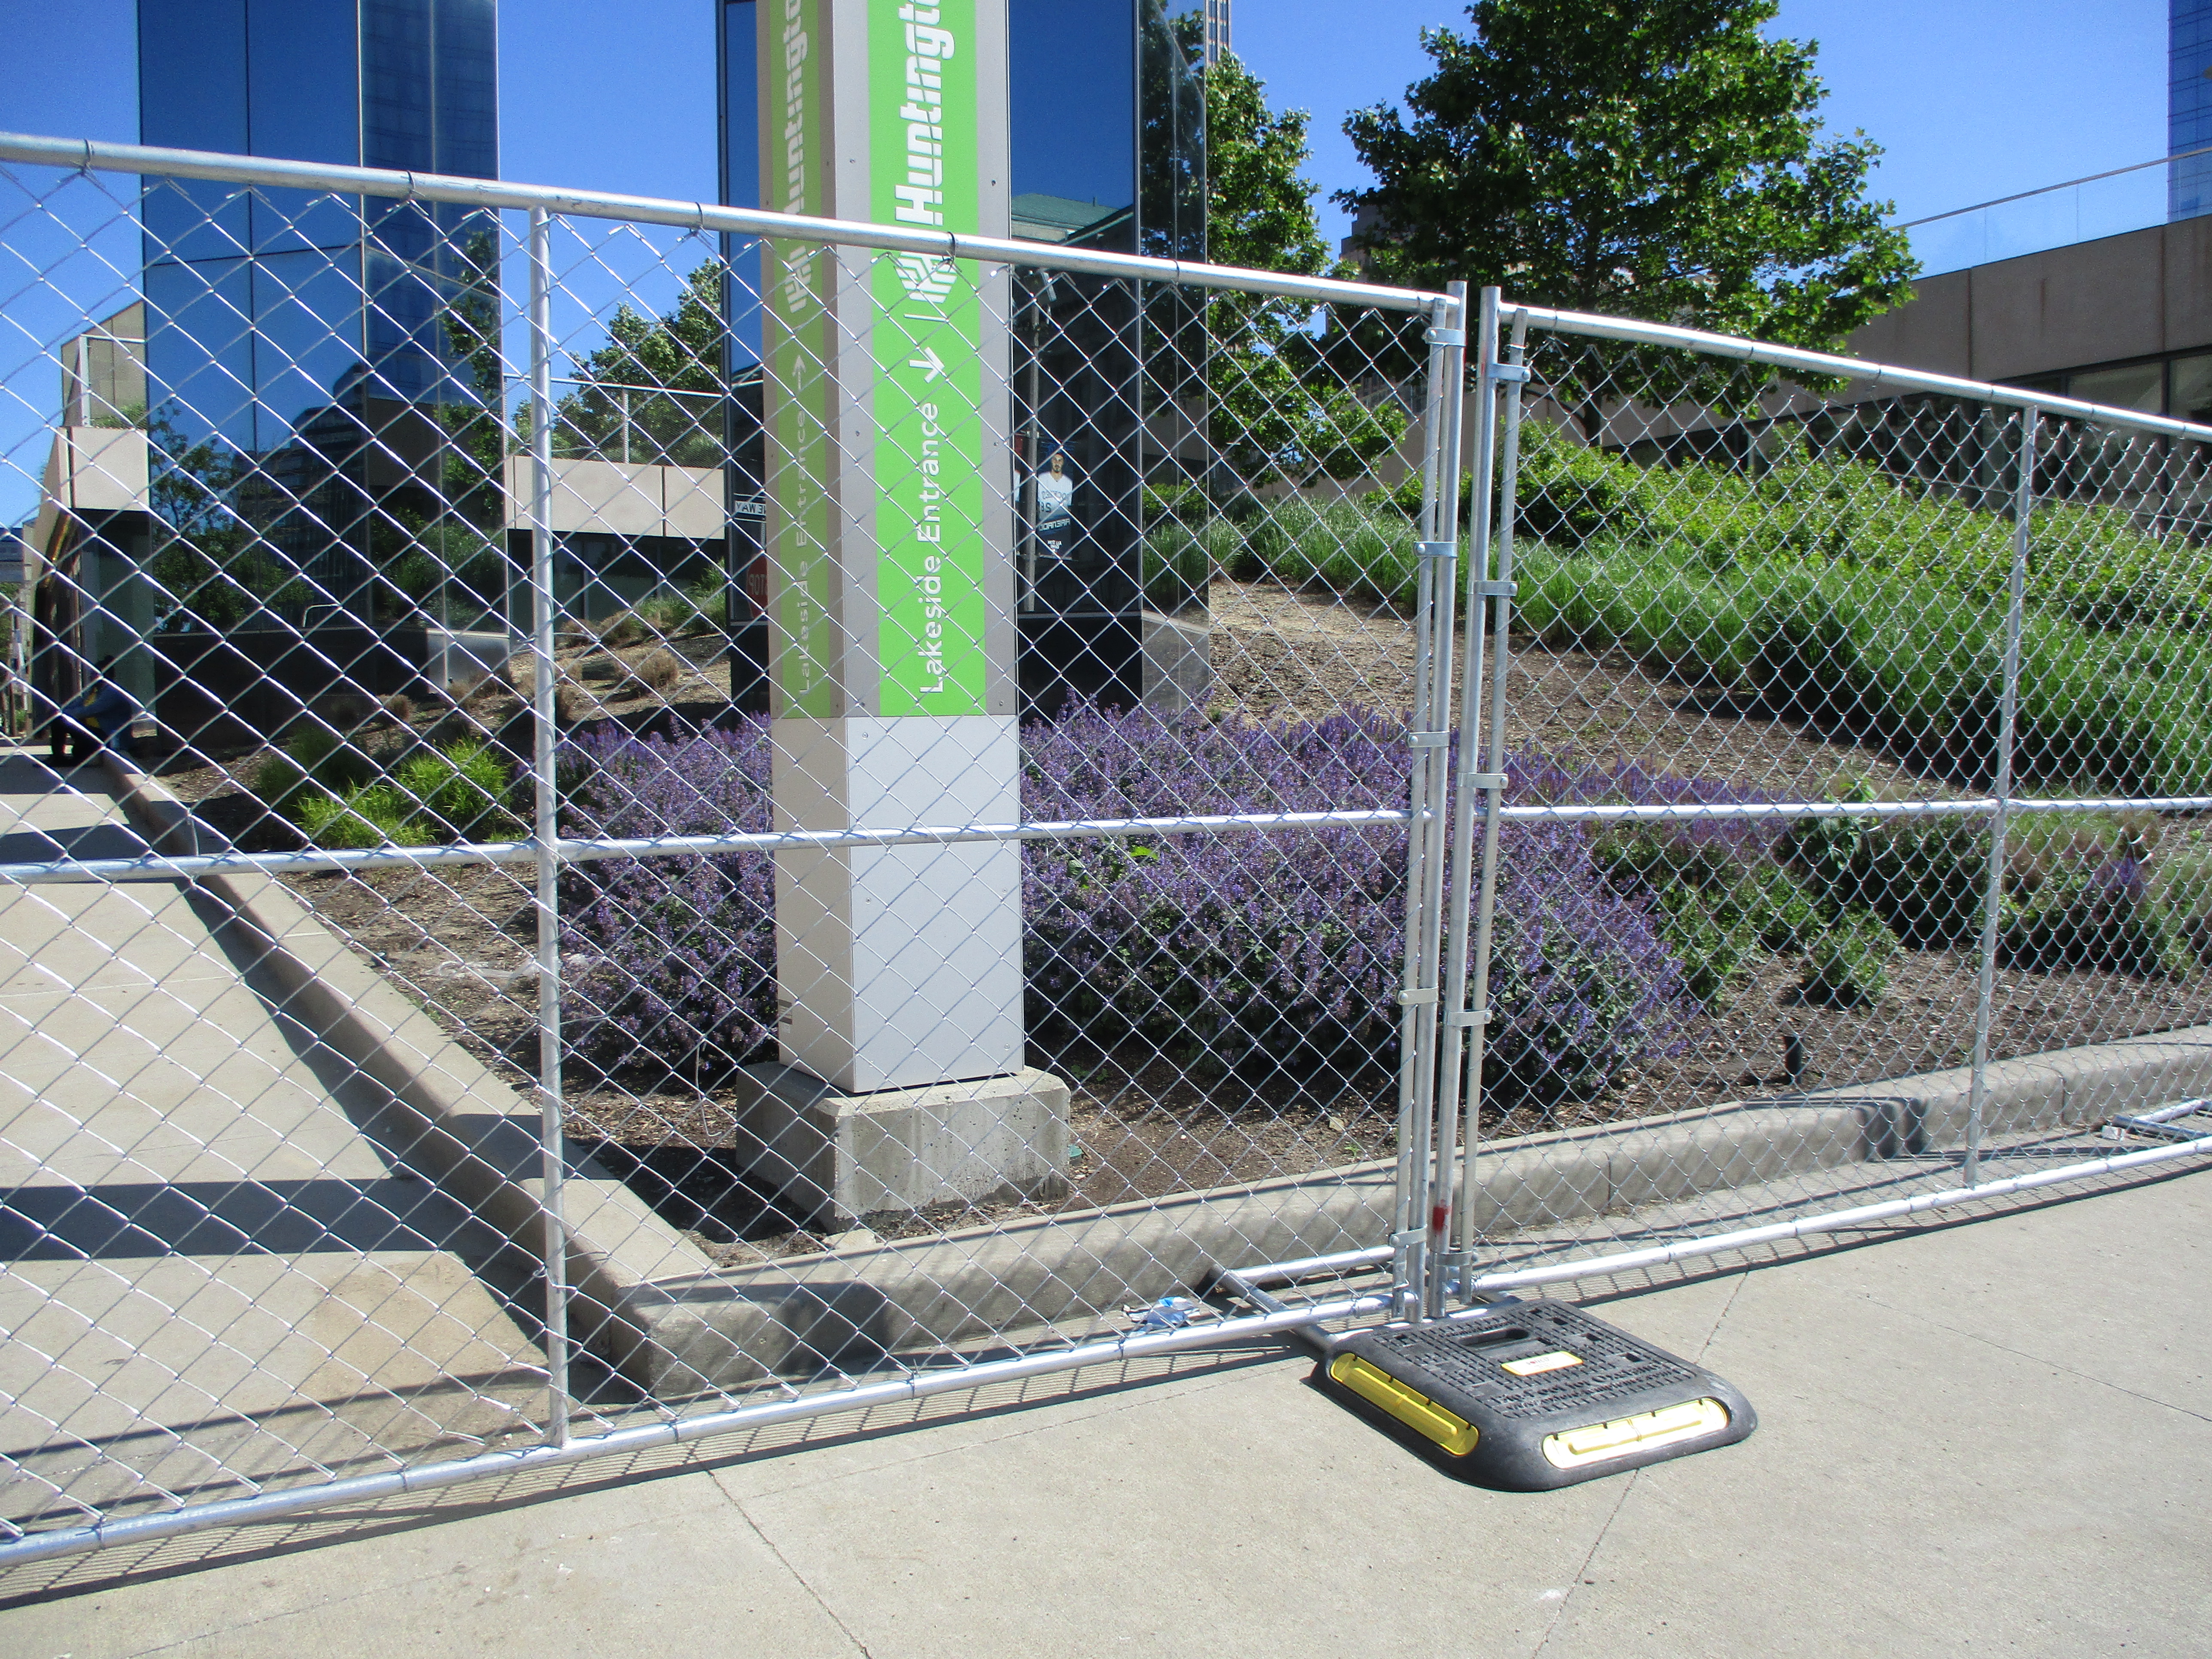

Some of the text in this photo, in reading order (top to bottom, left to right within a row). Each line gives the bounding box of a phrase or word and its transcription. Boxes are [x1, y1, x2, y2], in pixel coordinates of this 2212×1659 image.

[797, 561, 810, 694] Lakeside
[917, 402, 944, 693] Lakeside Entrance
